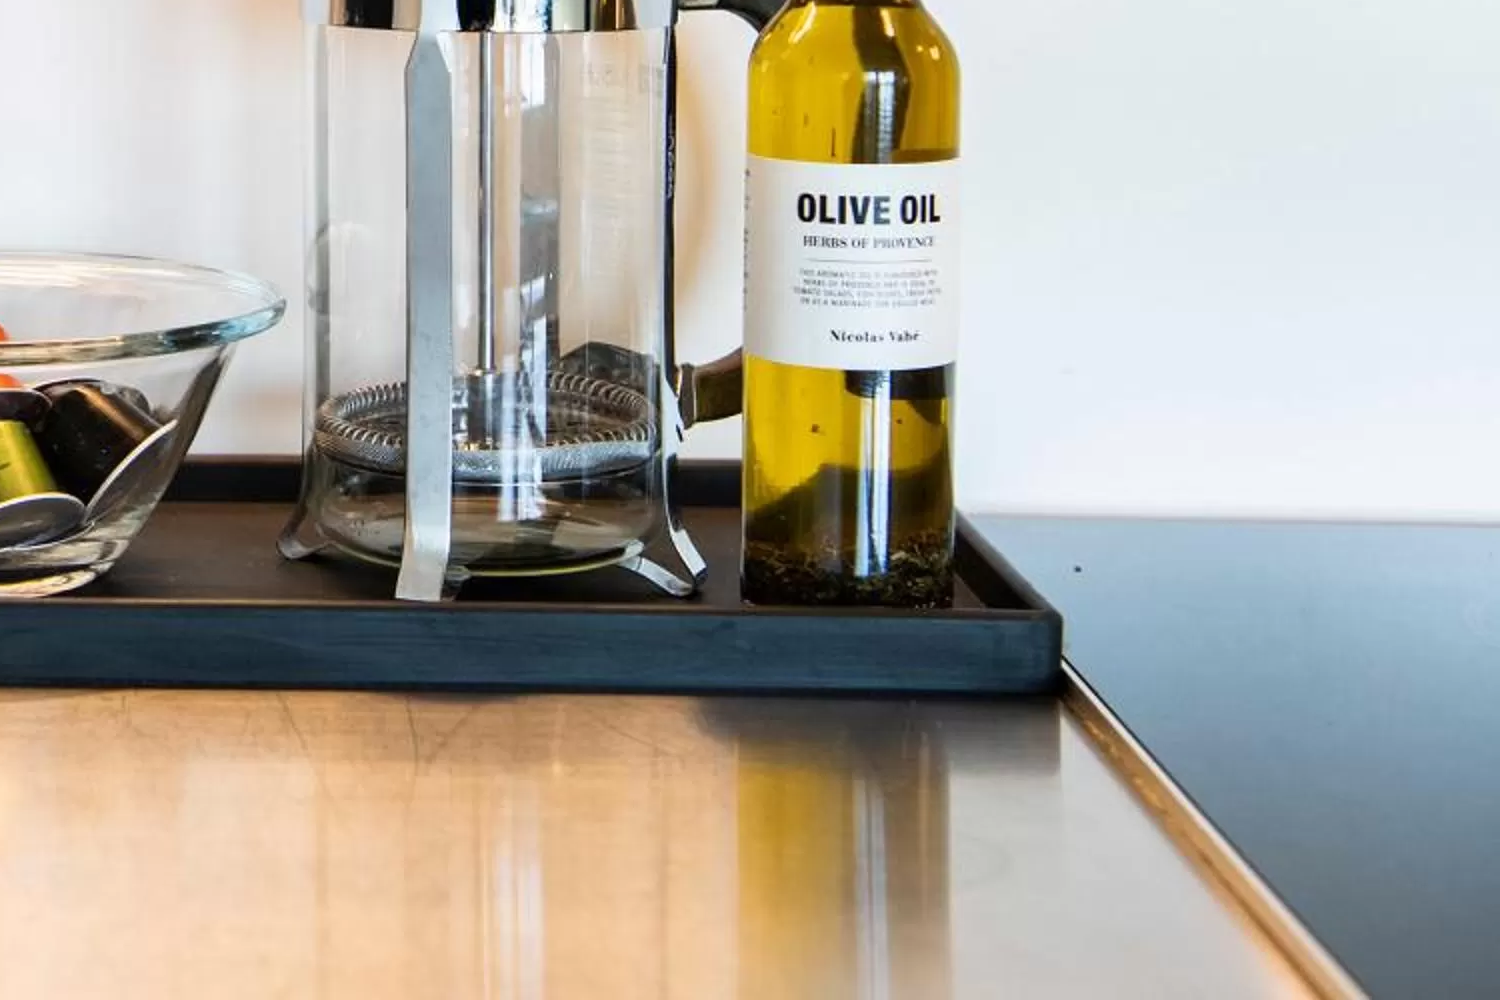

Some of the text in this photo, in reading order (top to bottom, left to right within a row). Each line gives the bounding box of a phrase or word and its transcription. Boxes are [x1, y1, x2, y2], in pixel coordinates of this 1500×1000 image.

[796, 192, 941, 225] OLIVE OIL
[803, 235, 935, 249] HERBS OF PROVENCE
[830, 329, 885, 343] Nicolas
